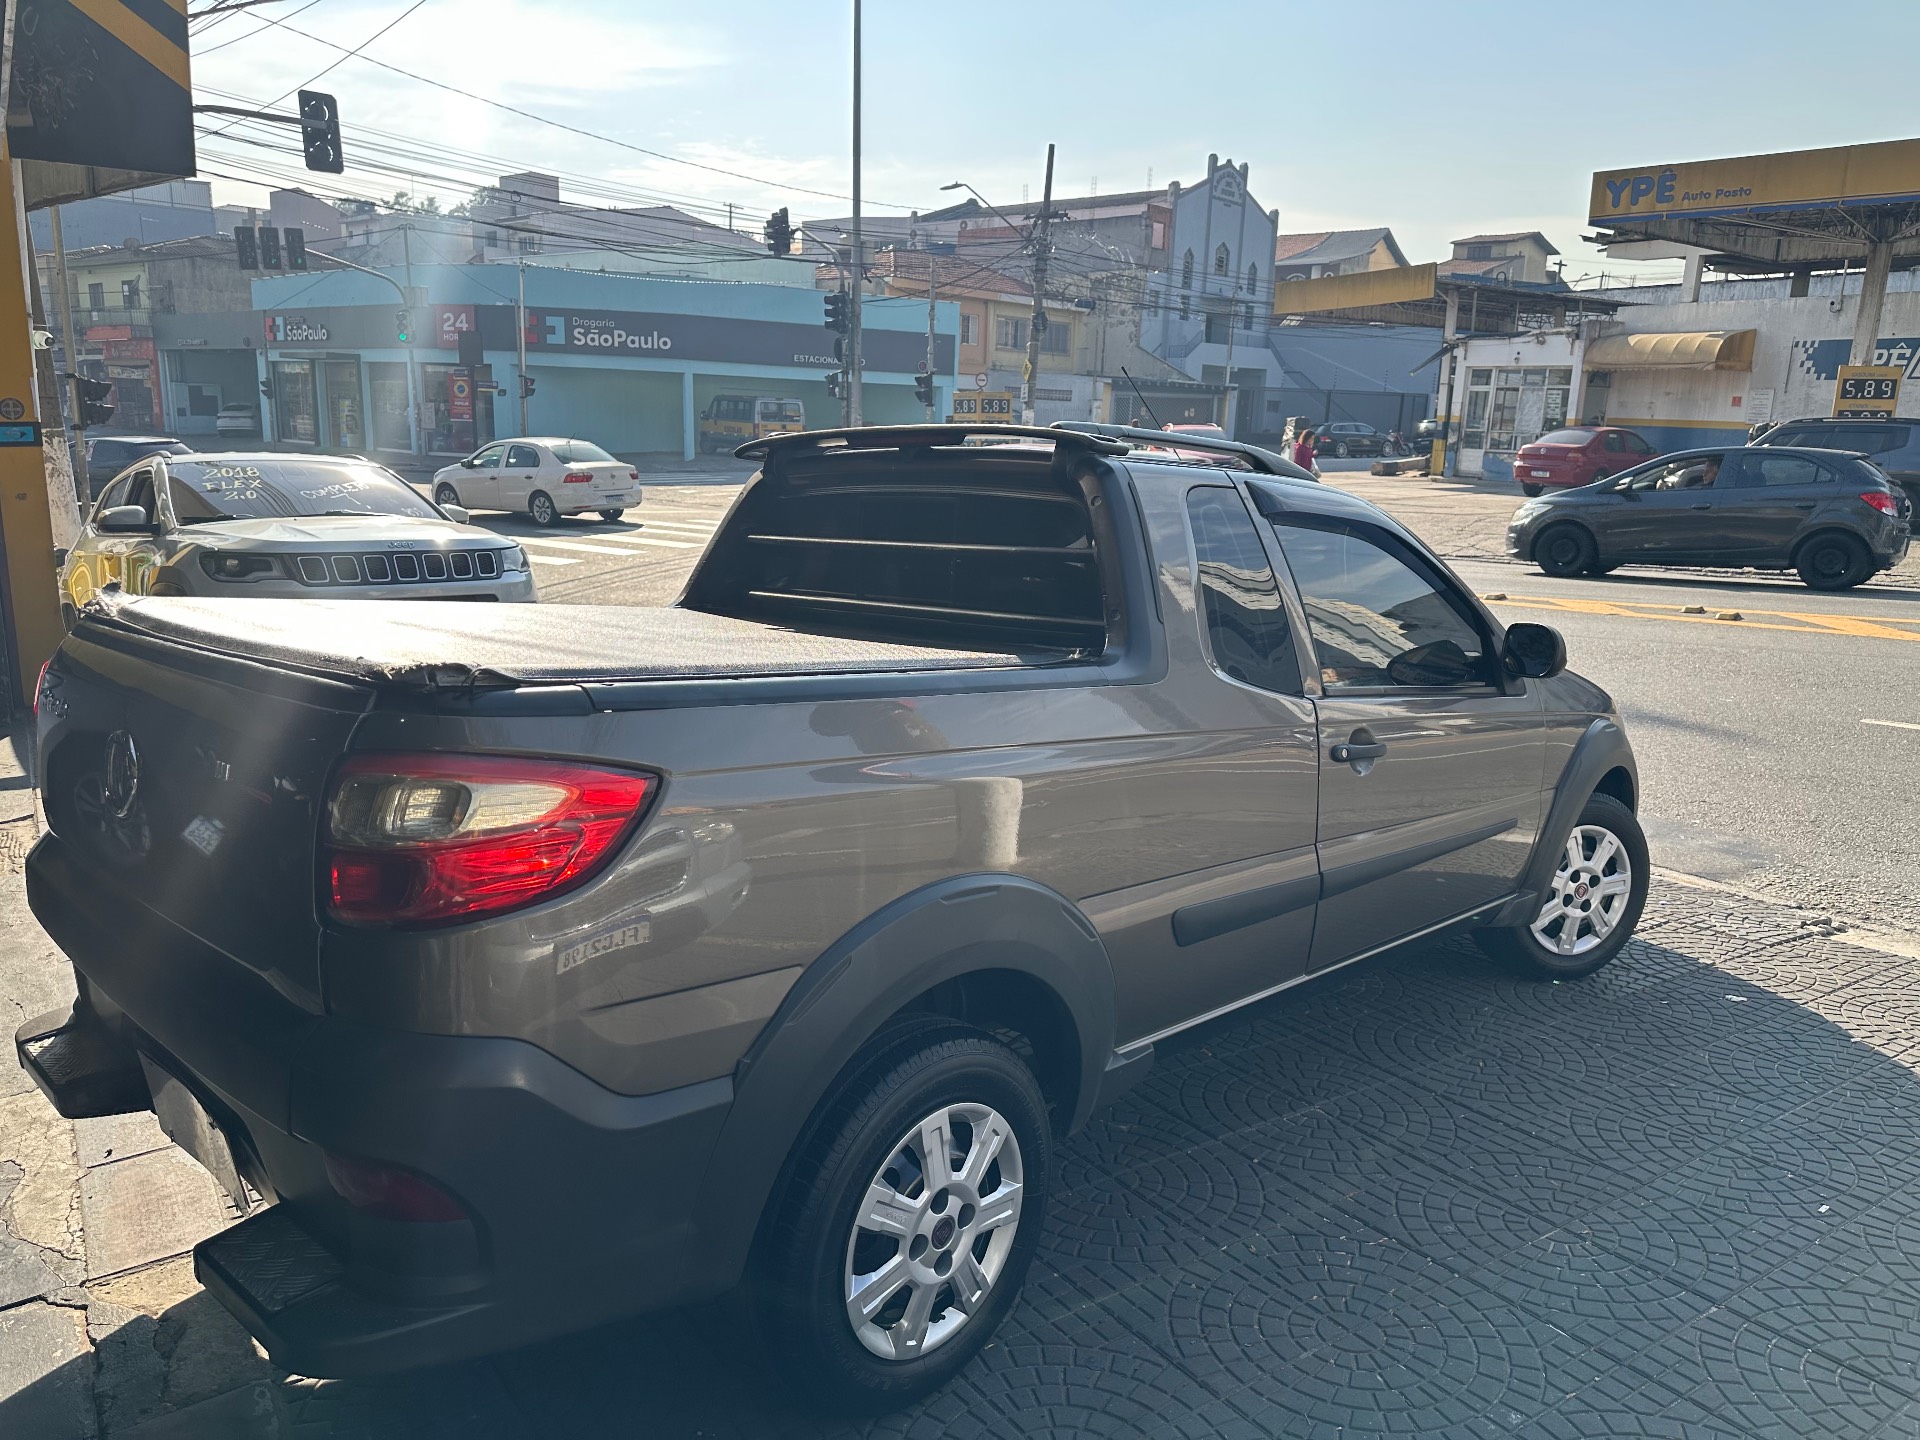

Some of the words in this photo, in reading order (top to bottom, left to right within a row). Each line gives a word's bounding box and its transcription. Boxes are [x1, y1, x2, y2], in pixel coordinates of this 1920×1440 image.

[1606, 168, 1677, 209] YPÊ
[1682, 191, 1711, 202] Auto
[1715, 186, 1752, 199] Posto
[443, 312, 468, 331] 24
[572, 317, 615, 328] Drogaria
[286, 324, 327, 341] SãoPaulo
[443, 333, 459, 341] HOR
[573, 328, 672, 350] SãoPaulo
[1845, 380, 1892, 399] 5,89
[203, 466, 260, 480] 2018
[202, 479, 262, 490] FLEX
[387, 540, 416, 550] Jeep
